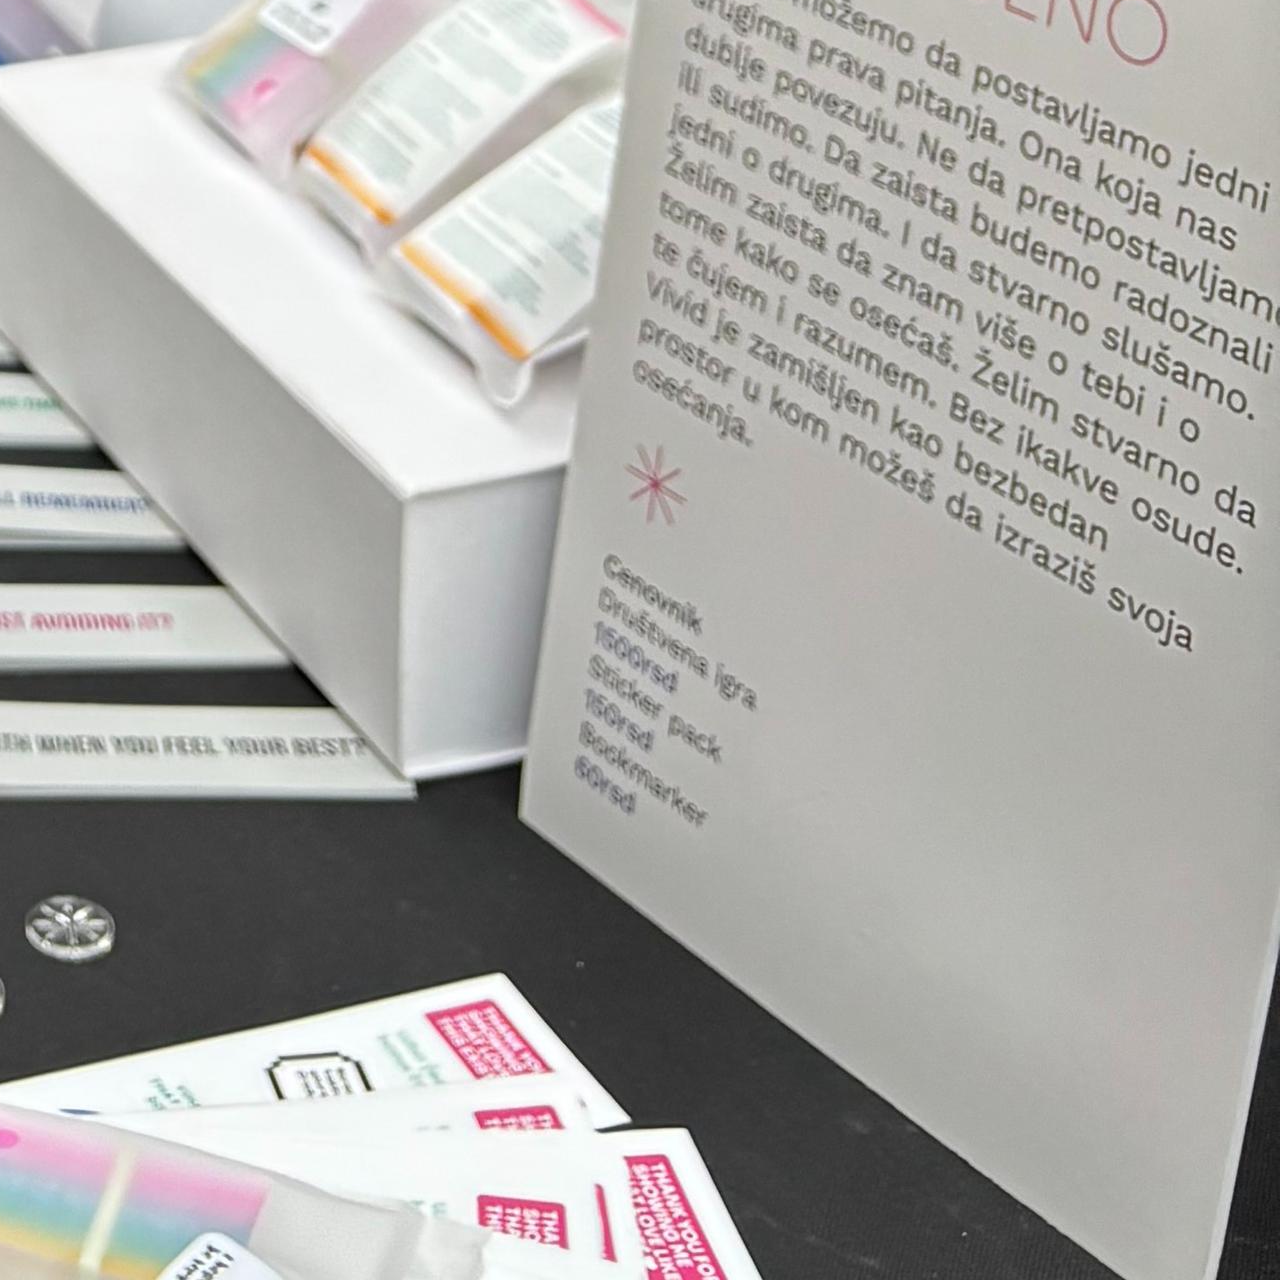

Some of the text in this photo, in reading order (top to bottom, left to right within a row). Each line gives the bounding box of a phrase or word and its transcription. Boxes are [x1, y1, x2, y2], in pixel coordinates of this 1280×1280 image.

[684, 23, 767, 82] dublje
[773, 69, 906, 151] povezuju.
[917, 130, 957, 172] Ne
[968, 158, 1005, 197] da
[808, 38, 886, 92] prava
[895, 78, 1005, 147] pitanja.
[1020, 130, 1082, 182] Ona
[1095, 159, 1162, 218] koja
[1176, 205, 1237, 251] nas
[926, 40, 961, 79] da
[973, 64, 1171, 170] postavljamo
[1178, 149, 1271, 213] jedni
[664, 141, 1200, 443] Želim zaista da znam više o tebi i o
[666, 101, 1254, 421] jedni o drugima. I da stvarno slušamo.
[677, 59, 1273, 374] ili sudimo. Da zaista budemo radoznali
[646, 269, 1109, 553] Vivid je zamišljen kao bezbedan
[652, 232, 1243, 575] te čujem i razumem. Bez ikakve osude.
[659, 190, 1256, 529] tome kako se osećaš. Želim stvarno da
[638, 318, 1194, 653] prostor u kom možeš da izraziš svoja
[603, 553, 704, 636] Cenovnik
[714, 662, 759, 712] igra
[580, 720, 710, 828] Bookmarker
[589, 654, 723, 764] Sticker pack
[650, 1161, 688, 1220] THANK
[677, 1218, 706, 1254] YOU
[668, 1243, 694, 1269] ME
